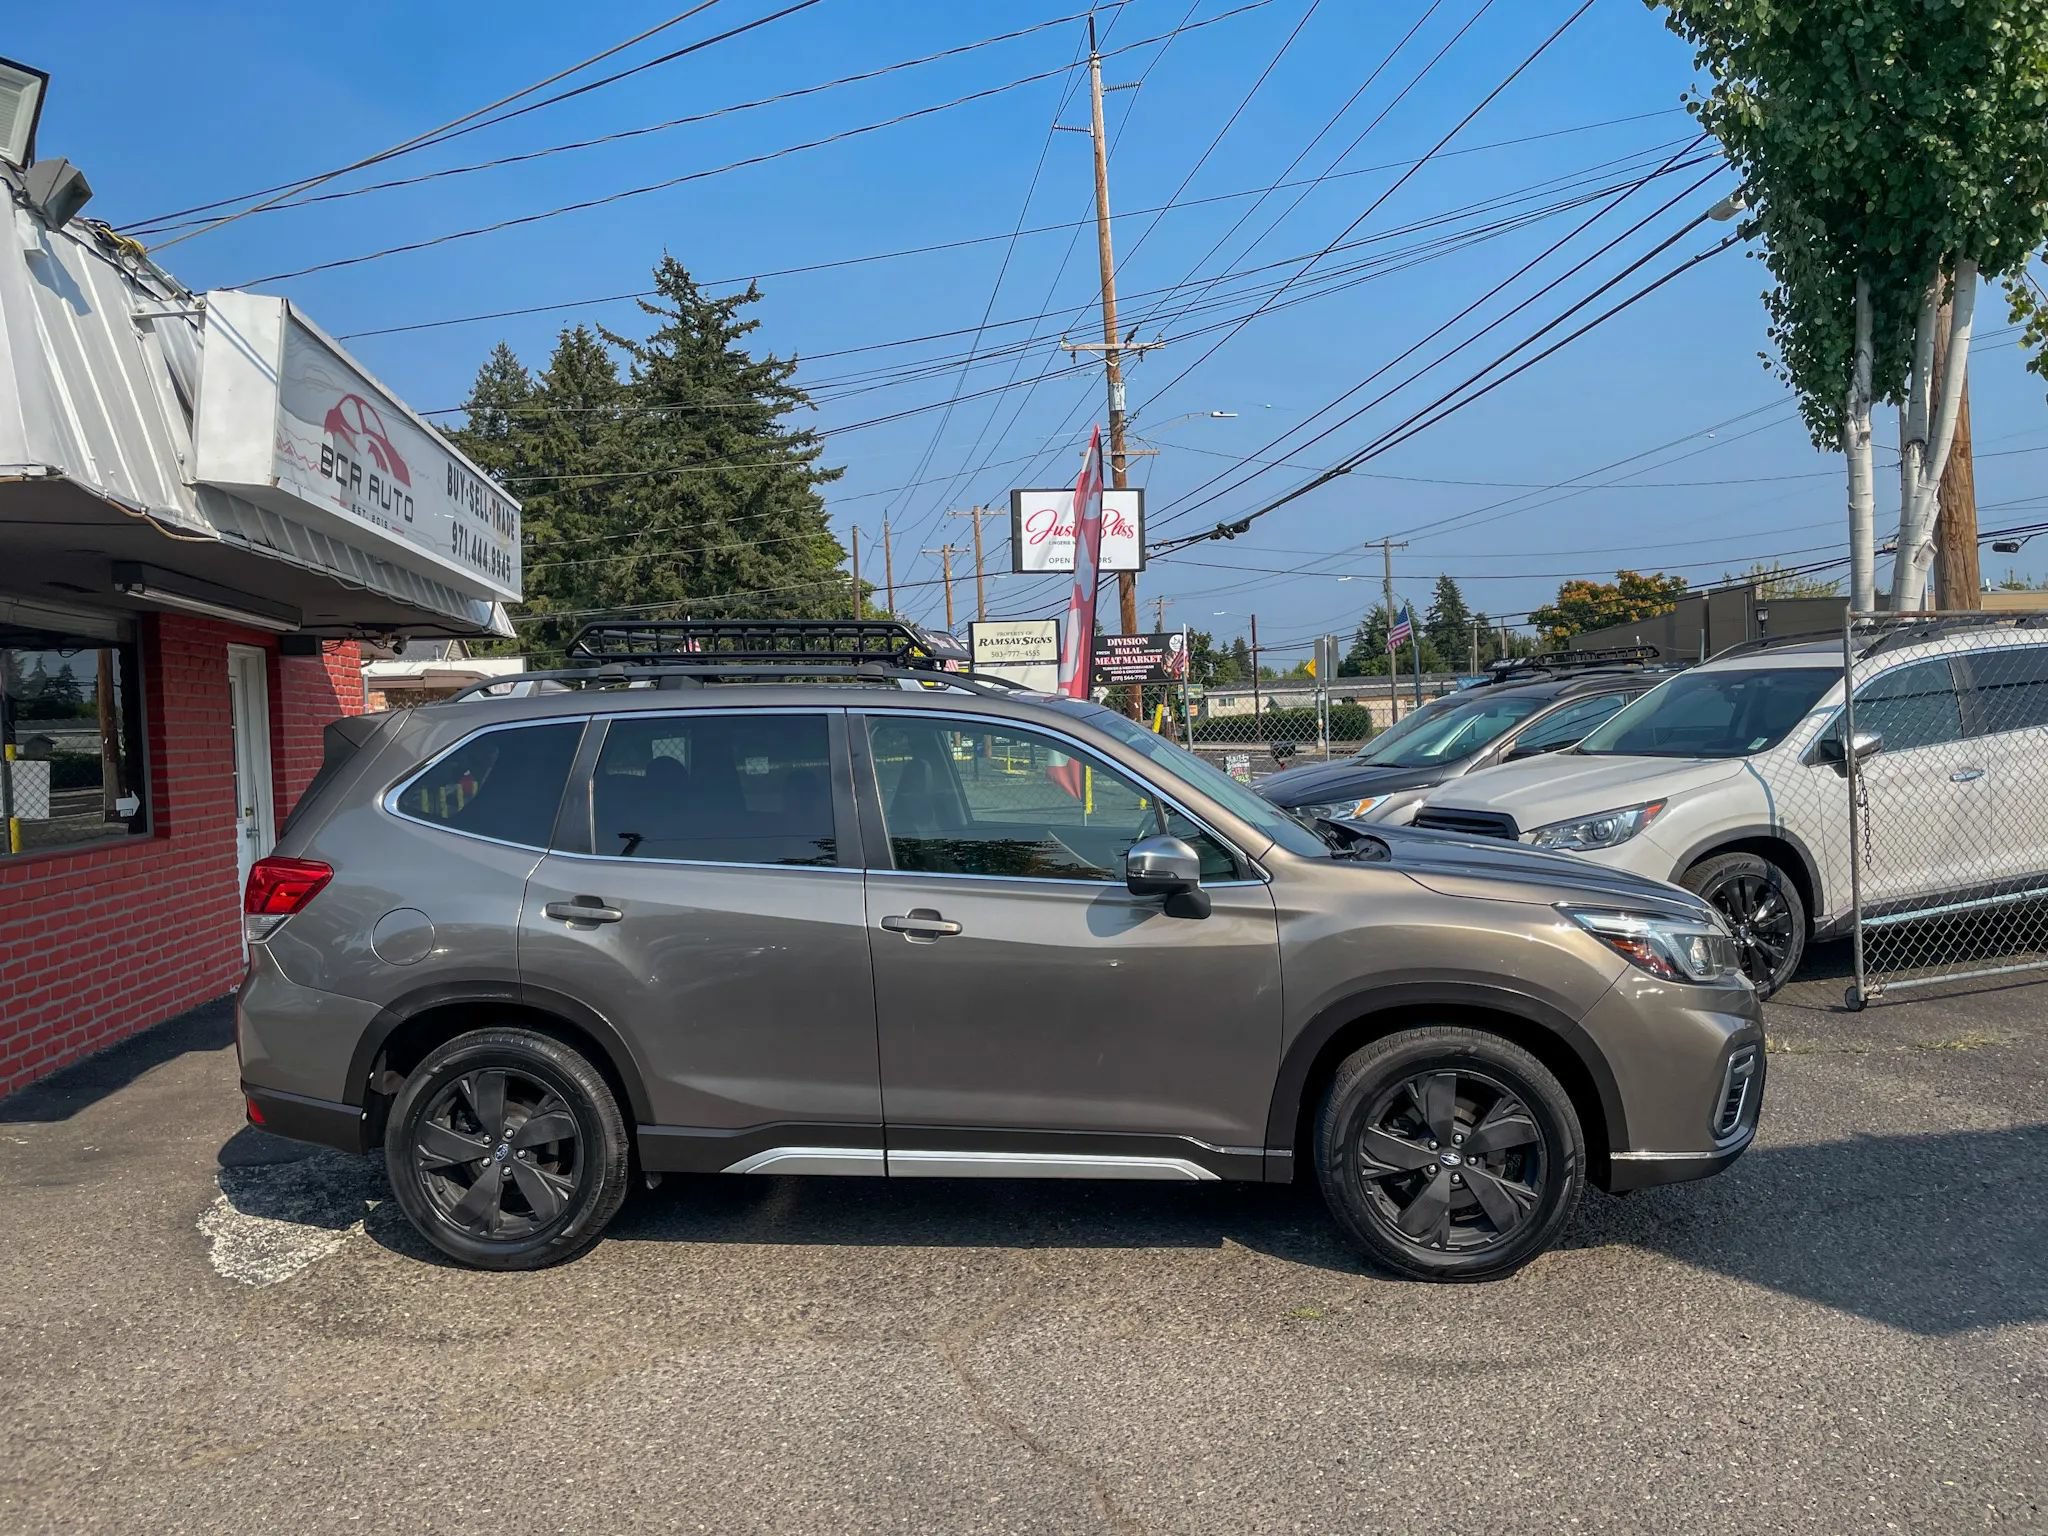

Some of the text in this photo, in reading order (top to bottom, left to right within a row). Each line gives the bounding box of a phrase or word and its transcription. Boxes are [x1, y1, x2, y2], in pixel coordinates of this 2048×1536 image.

[320, 443, 414, 523] BCR AUTO
[1048, 556, 1071, 564] OPEN
[1106, 637, 1149, 647] DIVISION
[1115, 647, 1142, 655] HALAL
[1094, 655, 1163, 666] MEAT MARKET
